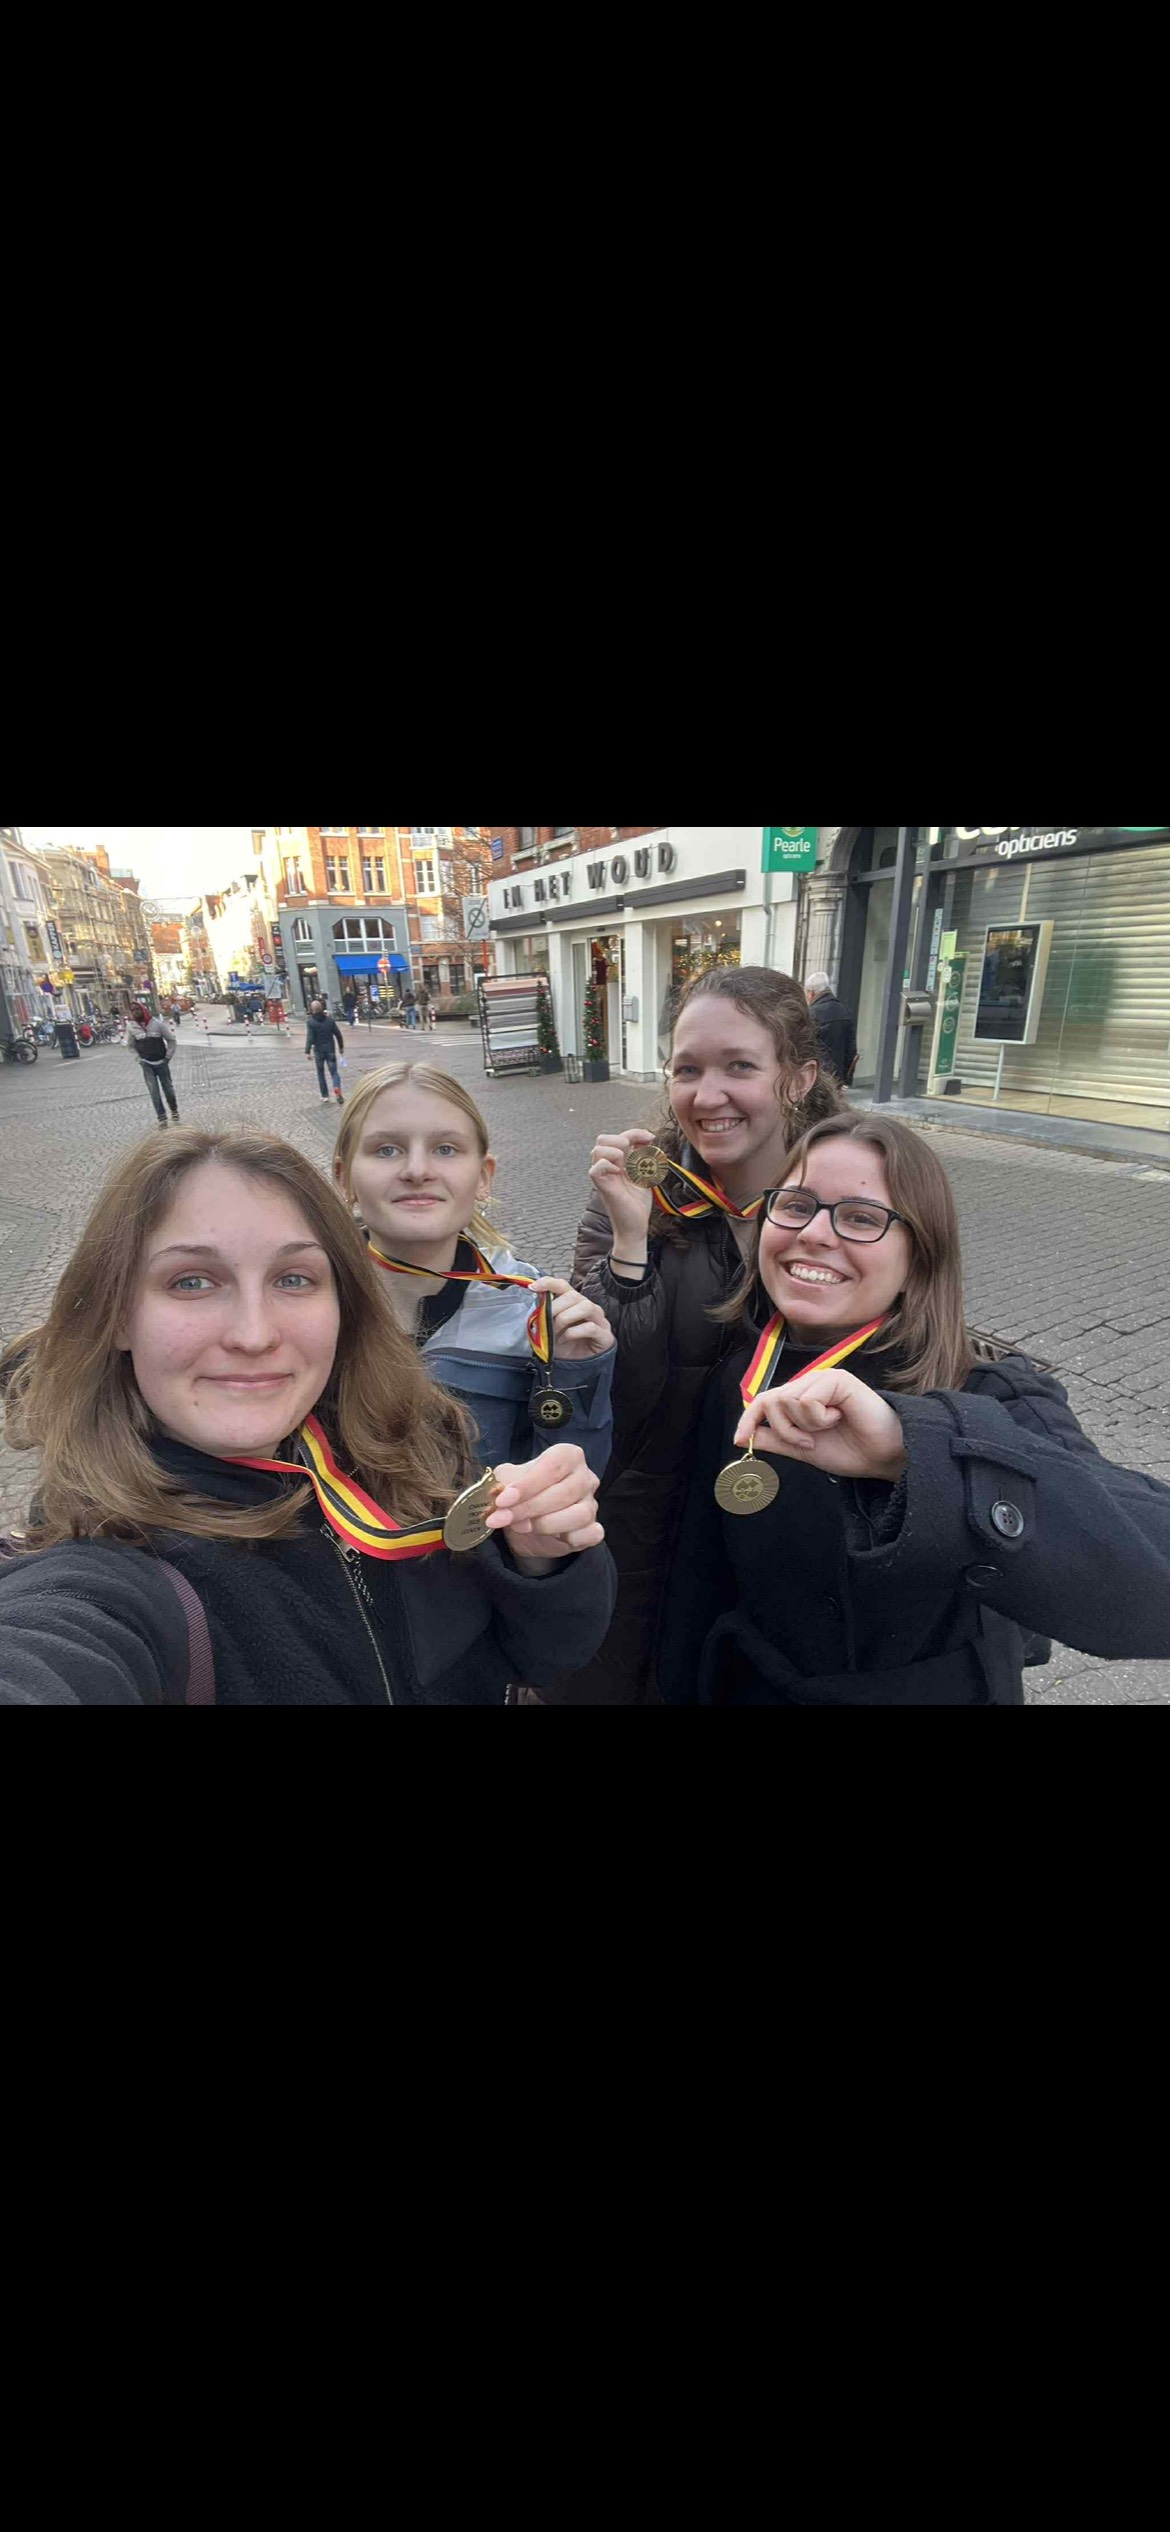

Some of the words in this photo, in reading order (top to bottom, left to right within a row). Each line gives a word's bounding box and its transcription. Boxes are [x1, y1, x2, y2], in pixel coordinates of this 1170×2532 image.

[774, 837, 811, 852] Pearle
[998, 829, 1078, 859] opticiens
[534, 871, 570, 902] HET
[586, 842, 674, 889] WOUD
